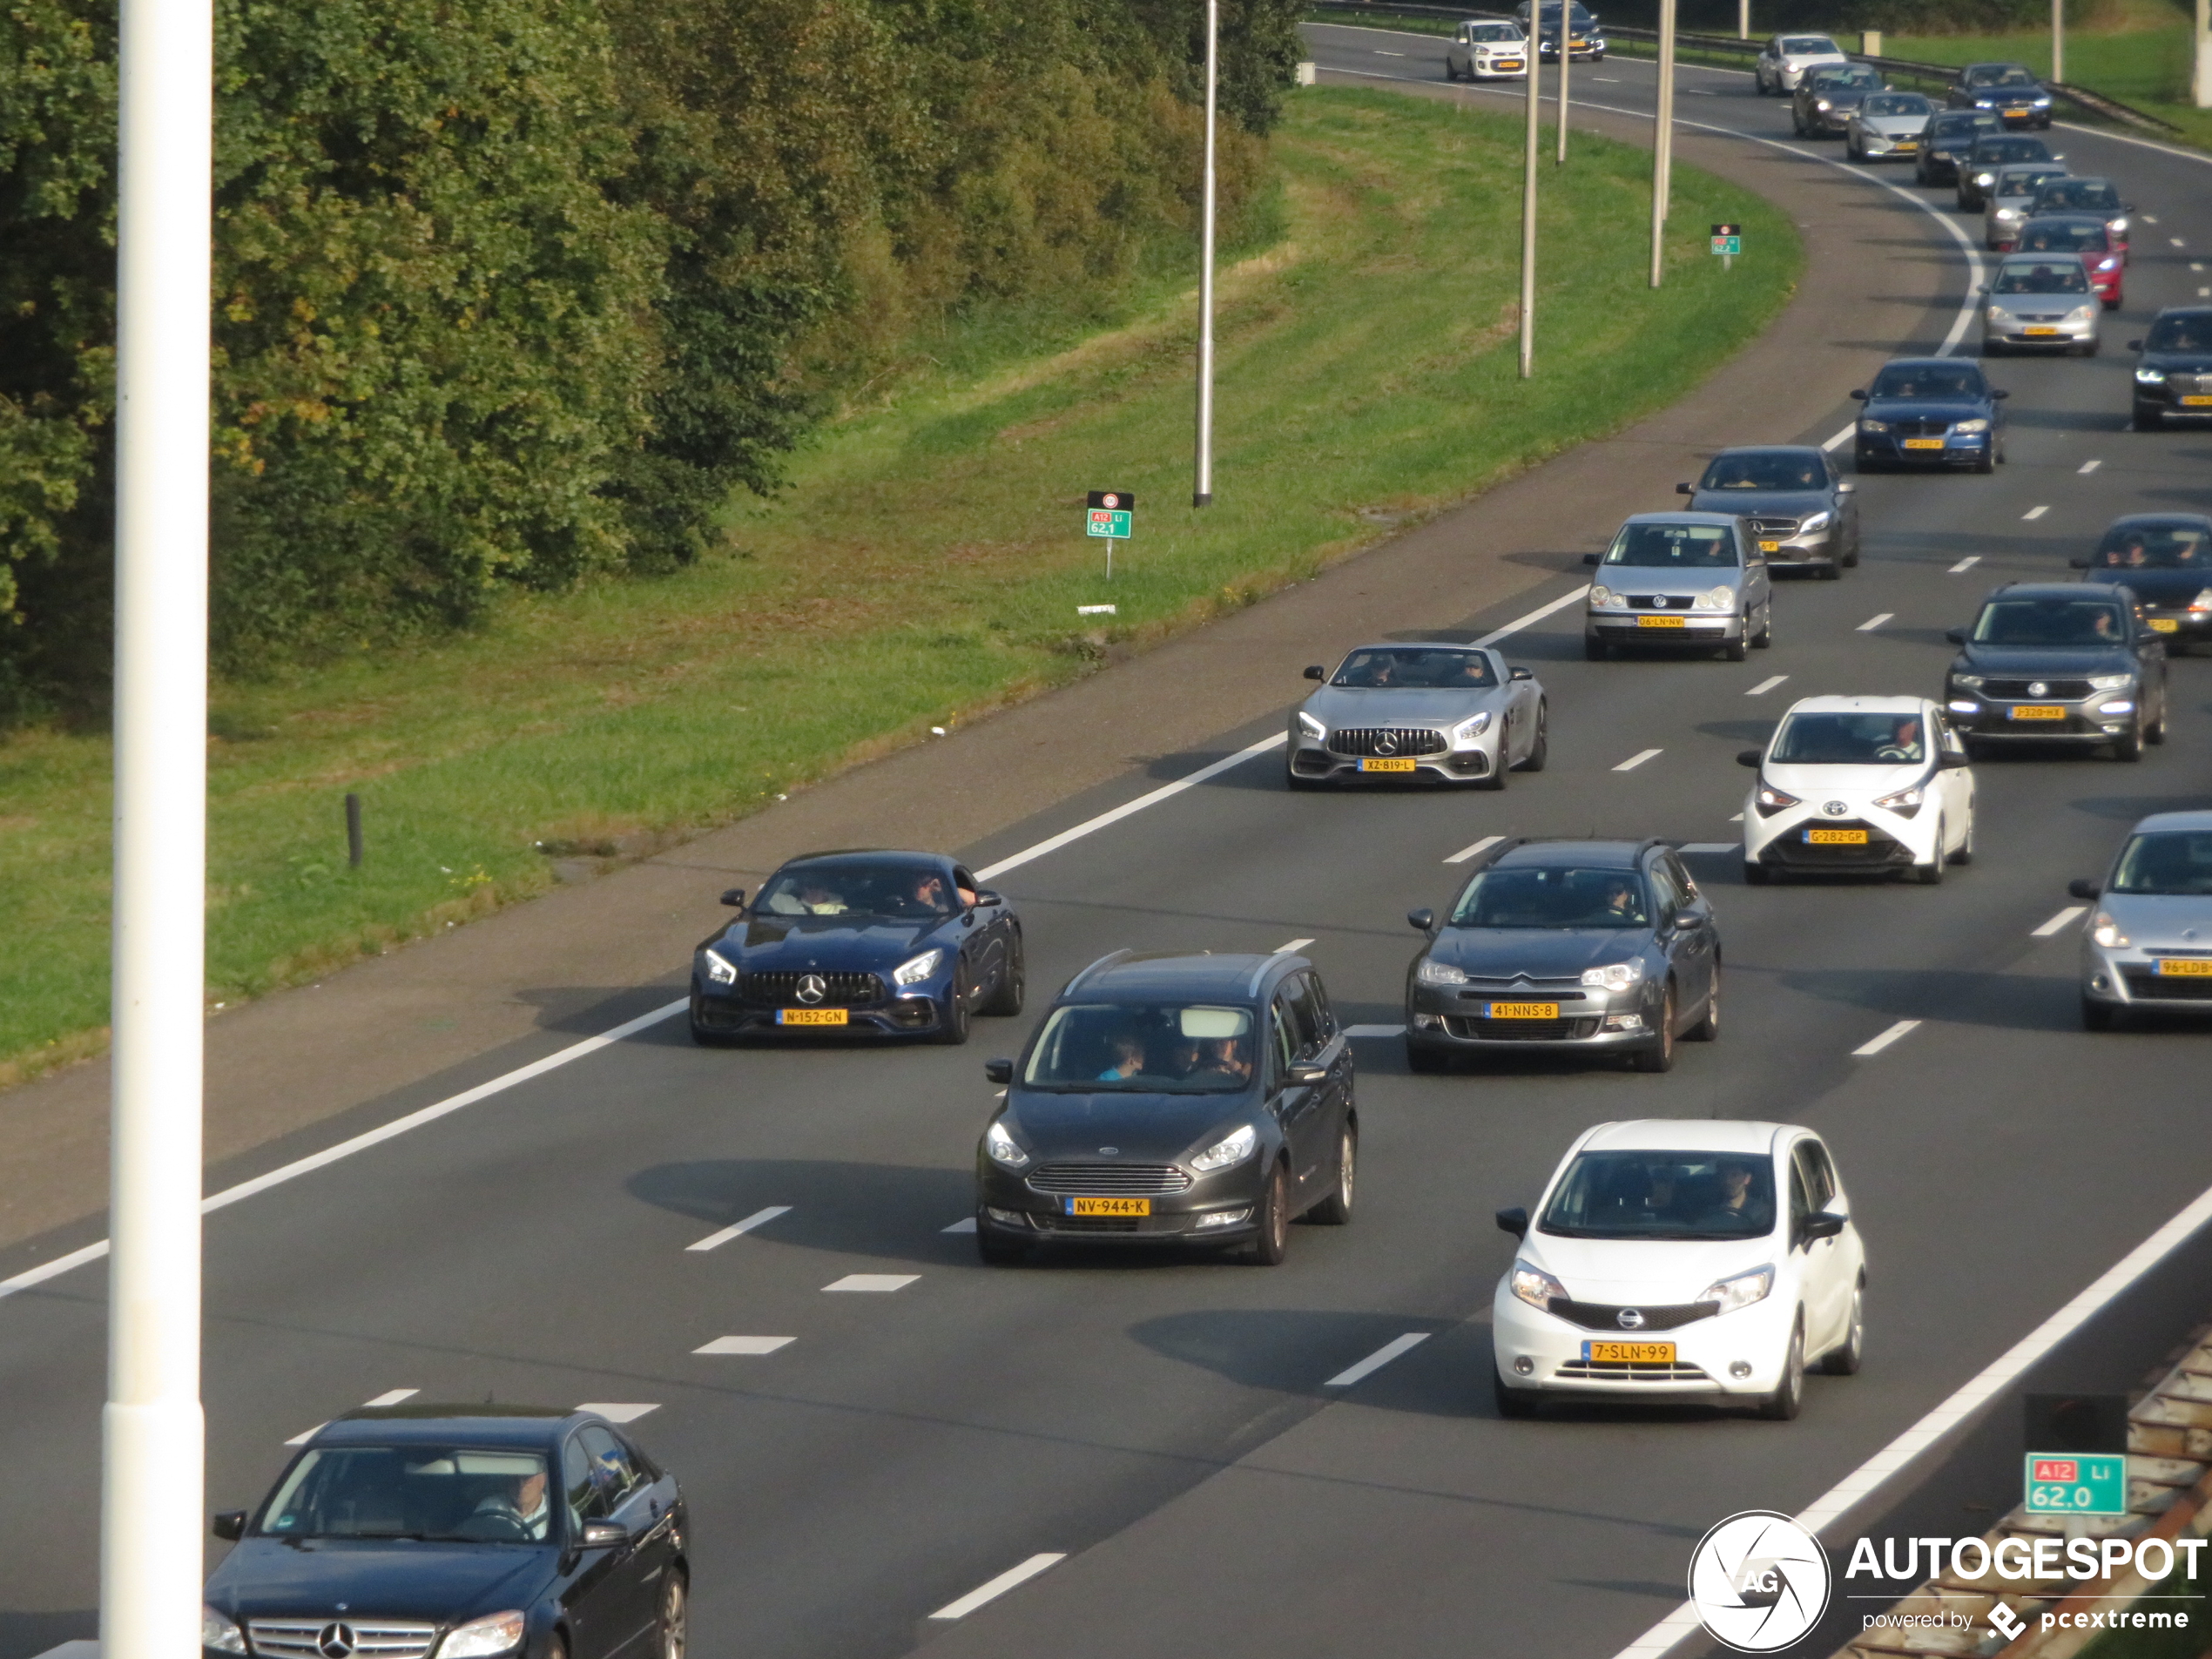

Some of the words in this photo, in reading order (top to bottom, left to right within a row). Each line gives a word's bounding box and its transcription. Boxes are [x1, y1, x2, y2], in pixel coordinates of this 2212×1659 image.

[1367, 760, 1410, 770] XZ-819-L
[1494, 1004, 1553, 1016] 41-NNS-8
[786, 1011, 842, 1023] N-152-GN
[1076, 1200, 1144, 1213] NV-944-K
[1595, 1344, 1669, 1359] 7-SLN-99
[2039, 1464, 2072, 1479] A12
[2091, 1465, 2110, 1480] Li
[2032, 1486, 2092, 1507] 62.0
